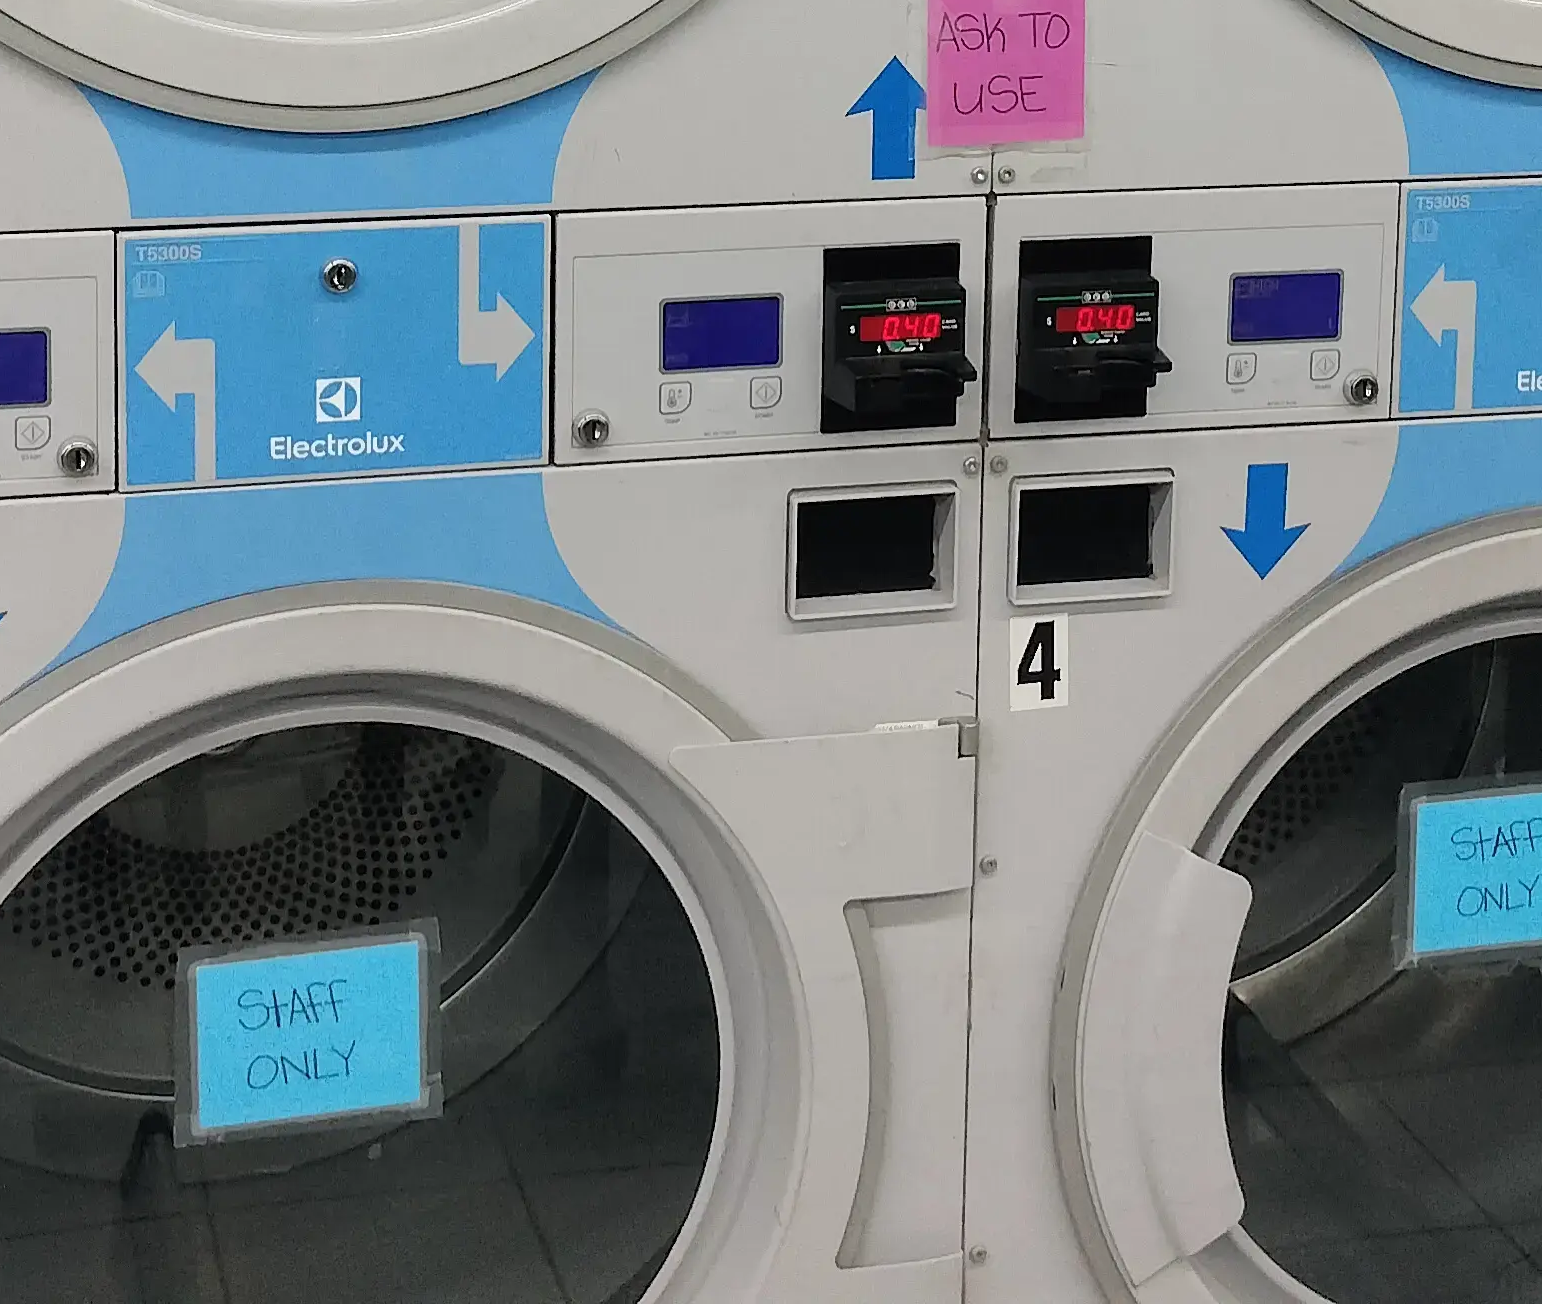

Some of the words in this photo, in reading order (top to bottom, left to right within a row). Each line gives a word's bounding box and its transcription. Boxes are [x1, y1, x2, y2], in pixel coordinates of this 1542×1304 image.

[936, 12, 1006, 53] ASK
[1018, 12, 1070, 49] TO
[953, 75, 1047, 115] USE
[1415, 194, 1470, 211] T5300S
[135, 245, 202, 262] T5300S
[883, 314, 940, 340] 0.40
[1076, 305, 1134, 331] 0.40
[269, 430, 405, 460] Electrolux
[1016, 620, 1061, 700] 4
[1457, 874, 1540, 916] ONLY
[247, 1039, 356, 1089] ONLY
